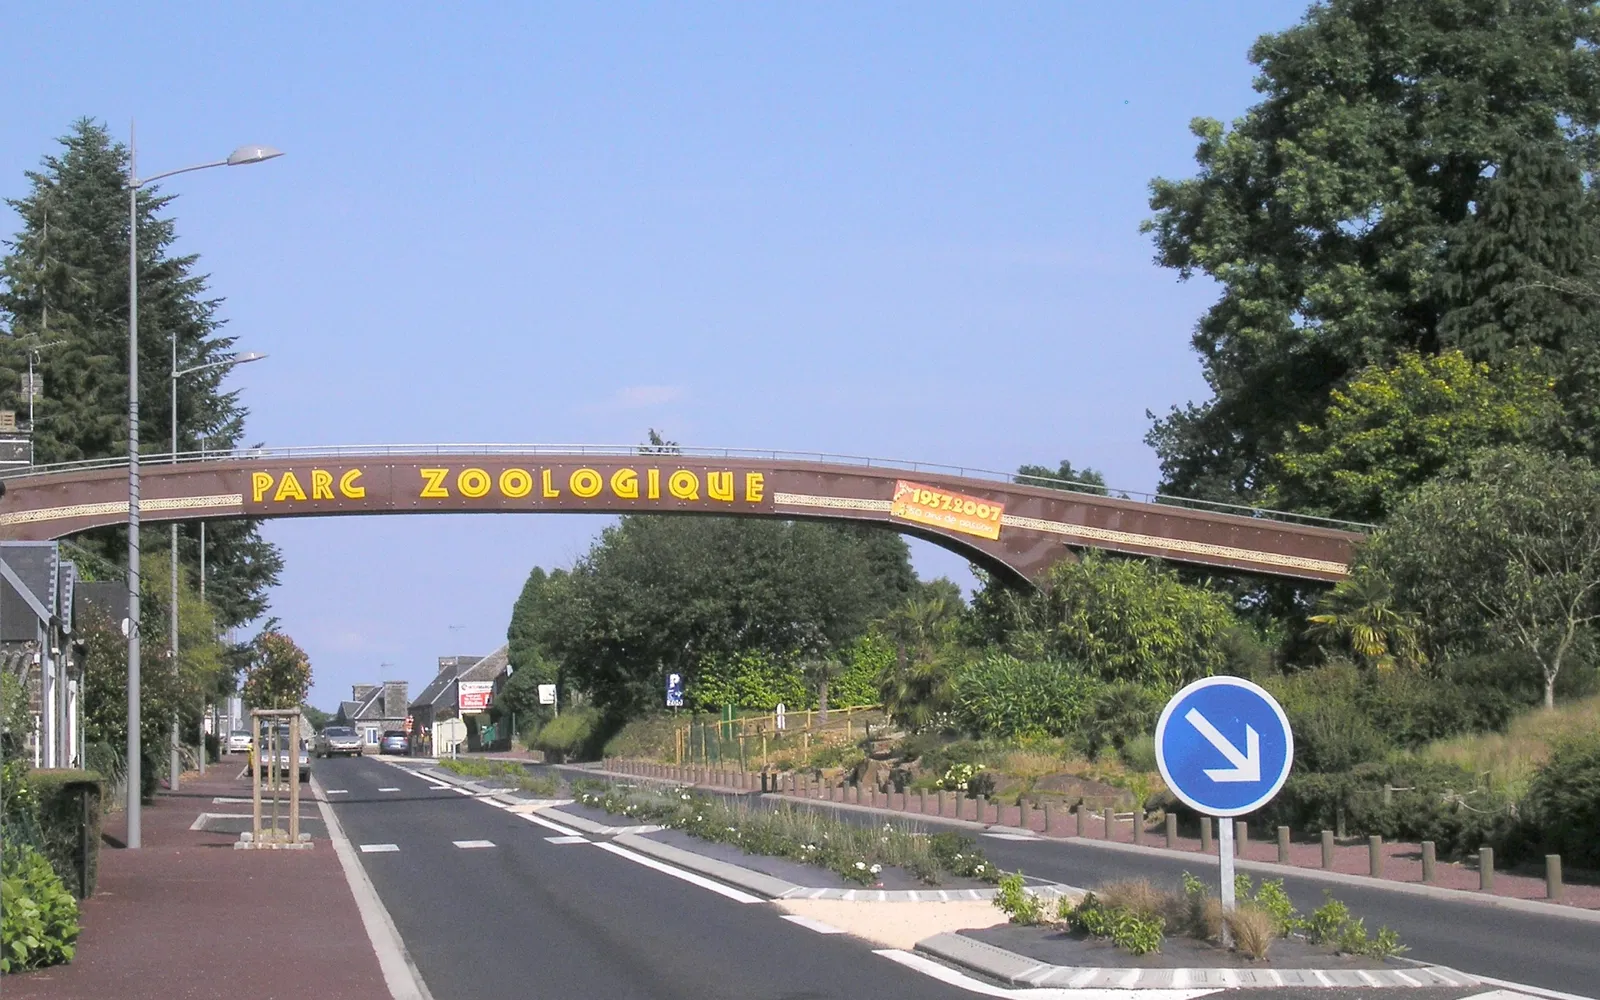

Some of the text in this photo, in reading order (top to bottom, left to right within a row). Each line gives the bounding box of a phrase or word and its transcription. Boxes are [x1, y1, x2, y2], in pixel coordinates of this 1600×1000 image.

[252, 467, 764, 502] PARC ZOOLOGIQUE
[944, 513, 957, 525] de
[669, 673, 681, 689] P
